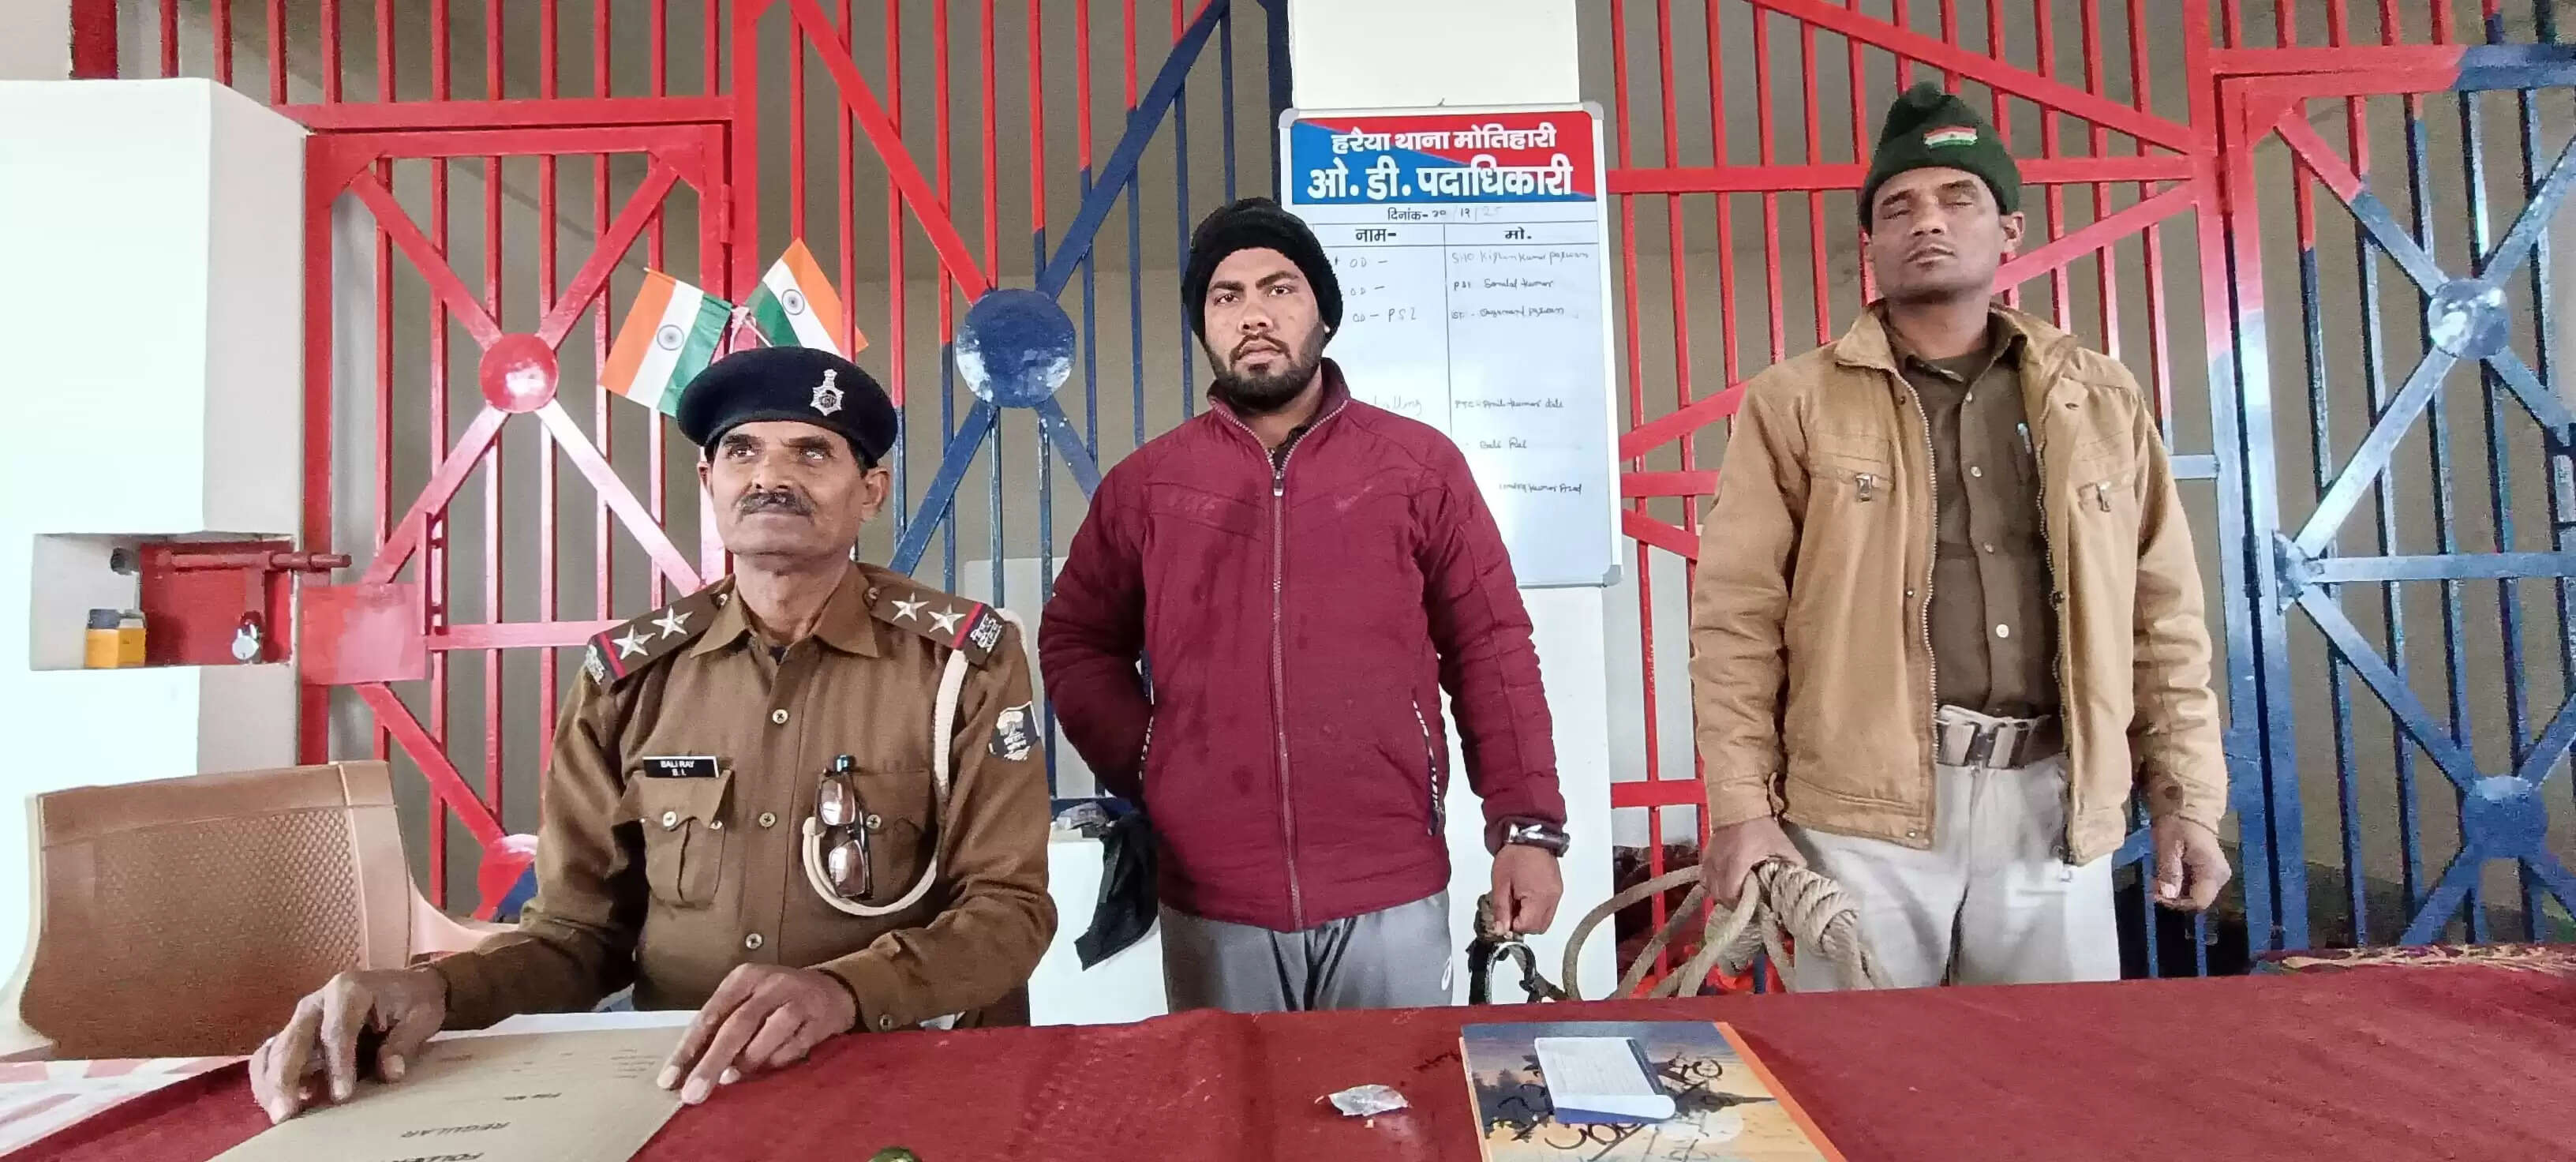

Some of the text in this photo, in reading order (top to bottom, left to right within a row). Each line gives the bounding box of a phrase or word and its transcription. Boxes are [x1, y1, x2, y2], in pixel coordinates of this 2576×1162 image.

[1331, 122, 1557, 155] हरैया थाना मोतिहारी
[1307, 153, 1574, 200] ओ. डी. पदाधिकारी
[400, 1121, 511, 1138] REGULAR
